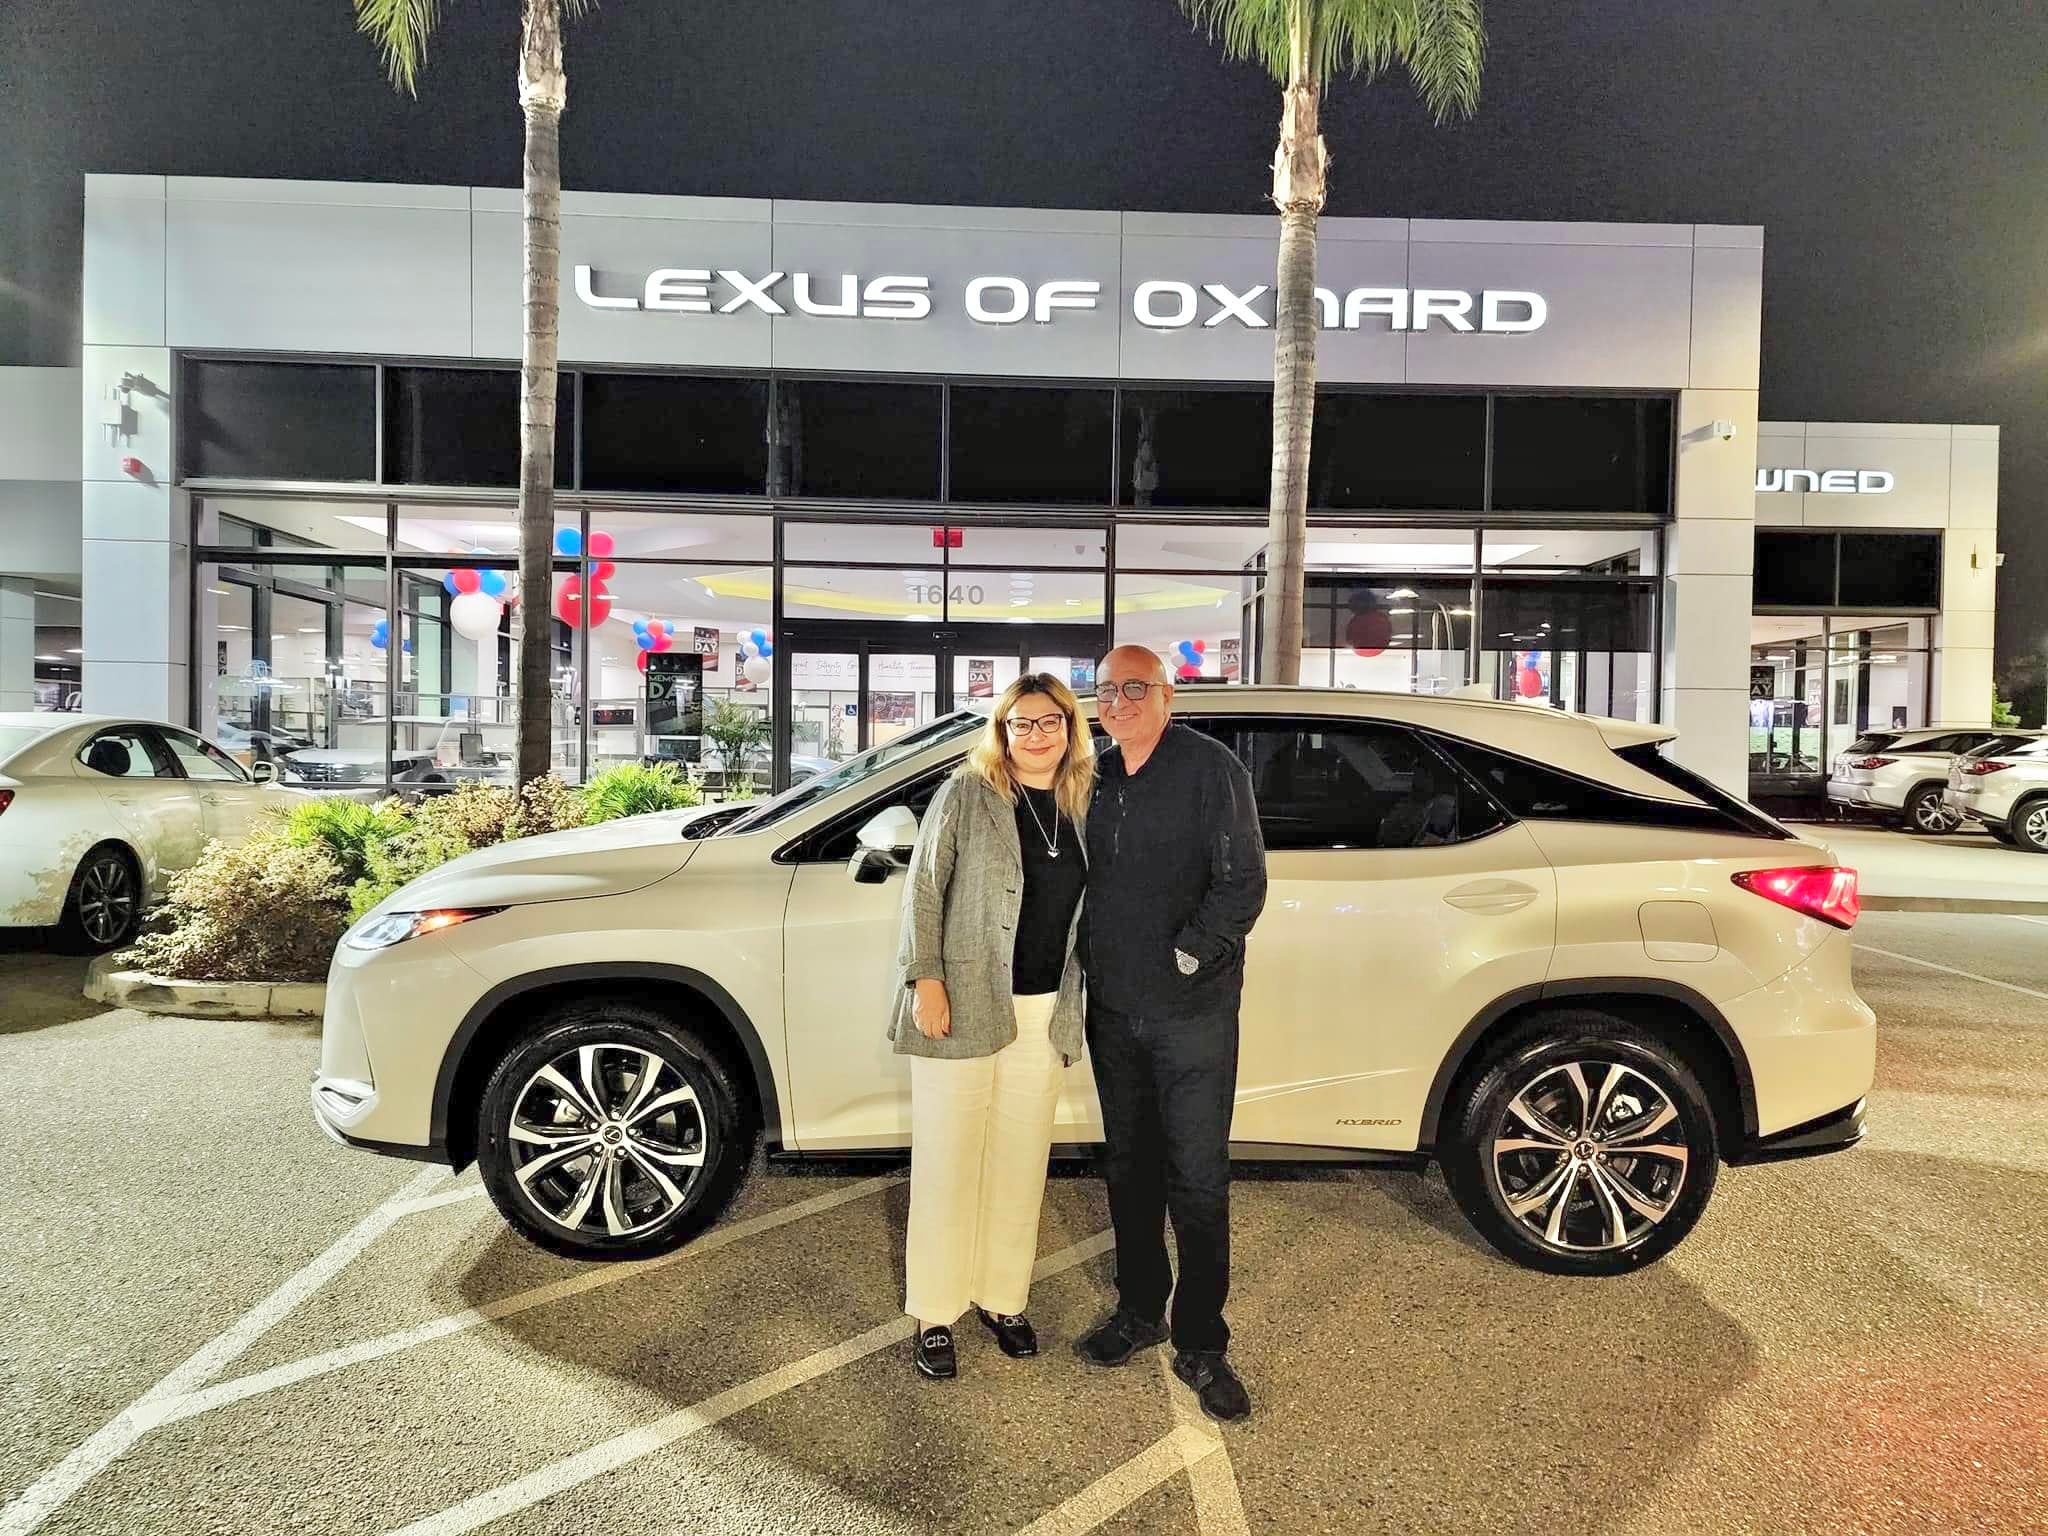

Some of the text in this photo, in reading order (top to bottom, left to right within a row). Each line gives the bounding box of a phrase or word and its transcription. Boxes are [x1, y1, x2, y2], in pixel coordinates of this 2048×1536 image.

[574, 264, 932, 320] LEXUS
[964, 275, 1101, 323] OF
[913, 584, 985, 605] 1640
[695, 642, 718, 653] DAY
[1222, 654, 1239, 664] DA
[970, 672, 992, 682] DAY
